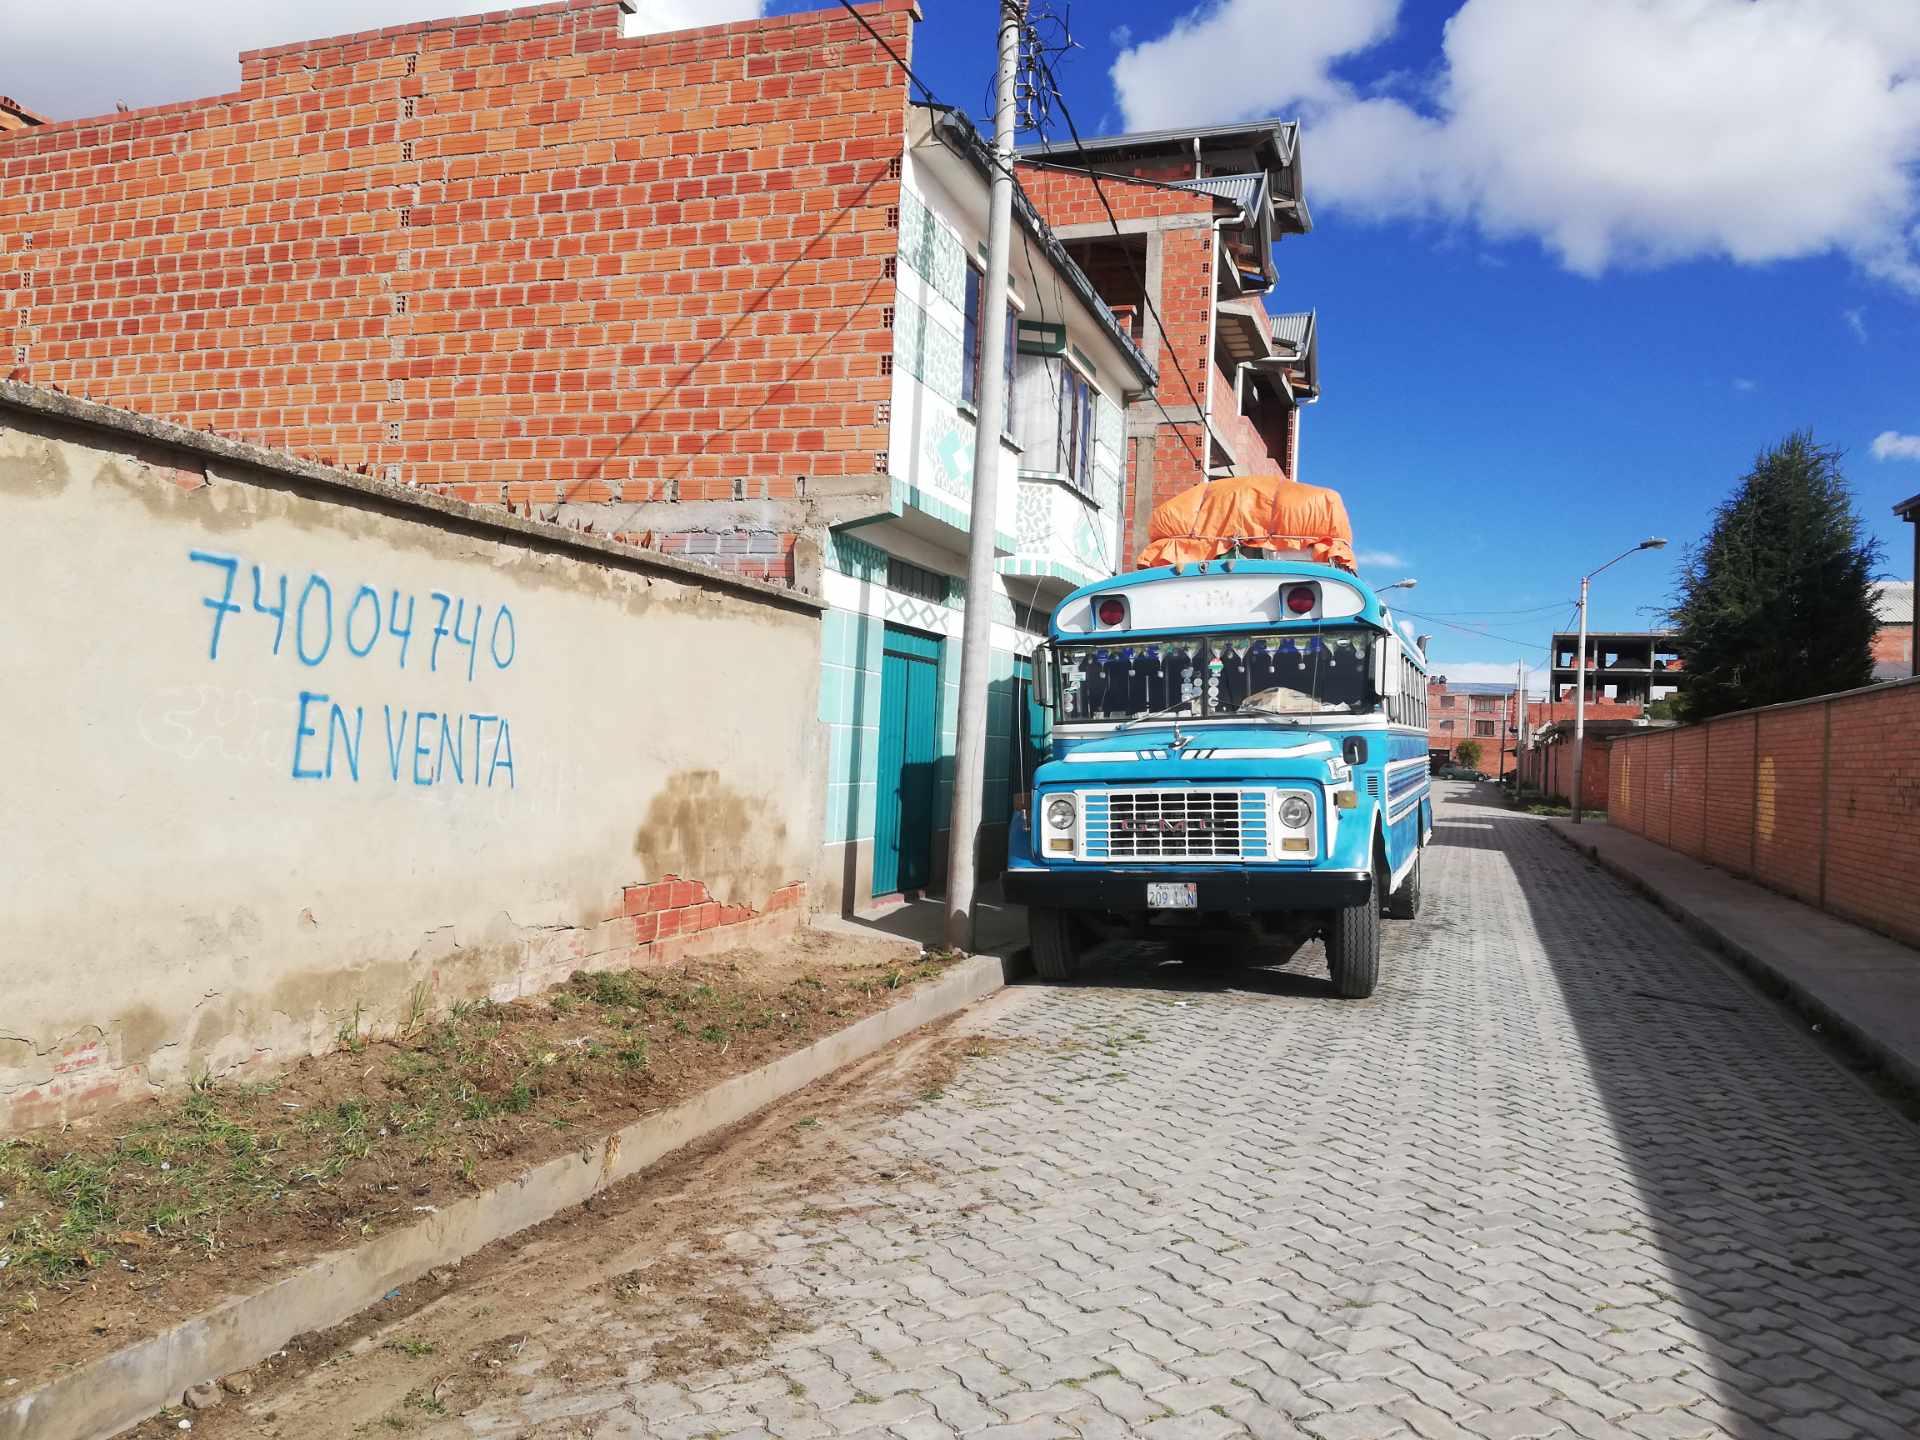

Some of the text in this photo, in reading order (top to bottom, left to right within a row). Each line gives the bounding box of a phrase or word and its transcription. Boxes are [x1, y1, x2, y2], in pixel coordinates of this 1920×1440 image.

[189, 550, 515, 682] 74004740
[292, 691, 363, 782] EN
[384, 705, 514, 788] VENTA
[1121, 818, 1226, 833] GMC
